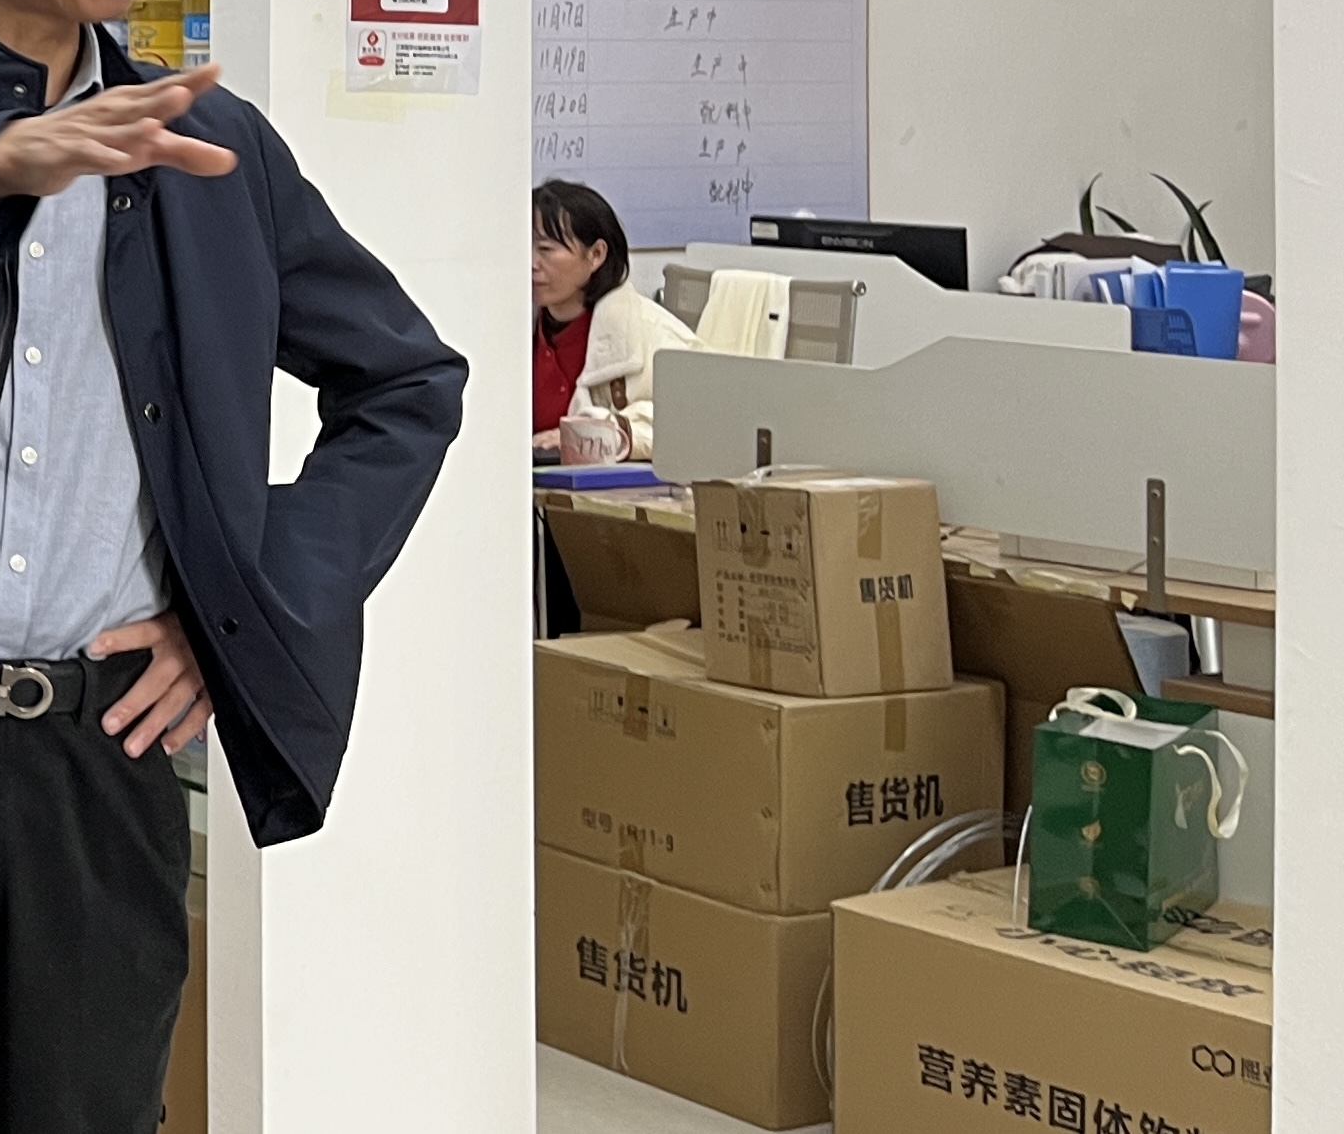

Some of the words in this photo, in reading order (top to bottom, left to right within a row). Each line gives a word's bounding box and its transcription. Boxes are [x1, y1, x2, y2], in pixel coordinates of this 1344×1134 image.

[859, 573, 914, 604] 售货机
[845, 774, 945, 828] 售货机
[576, 935, 689, 1014] 售货机
[917, 1043, 1210, 1134] 营养素固体
